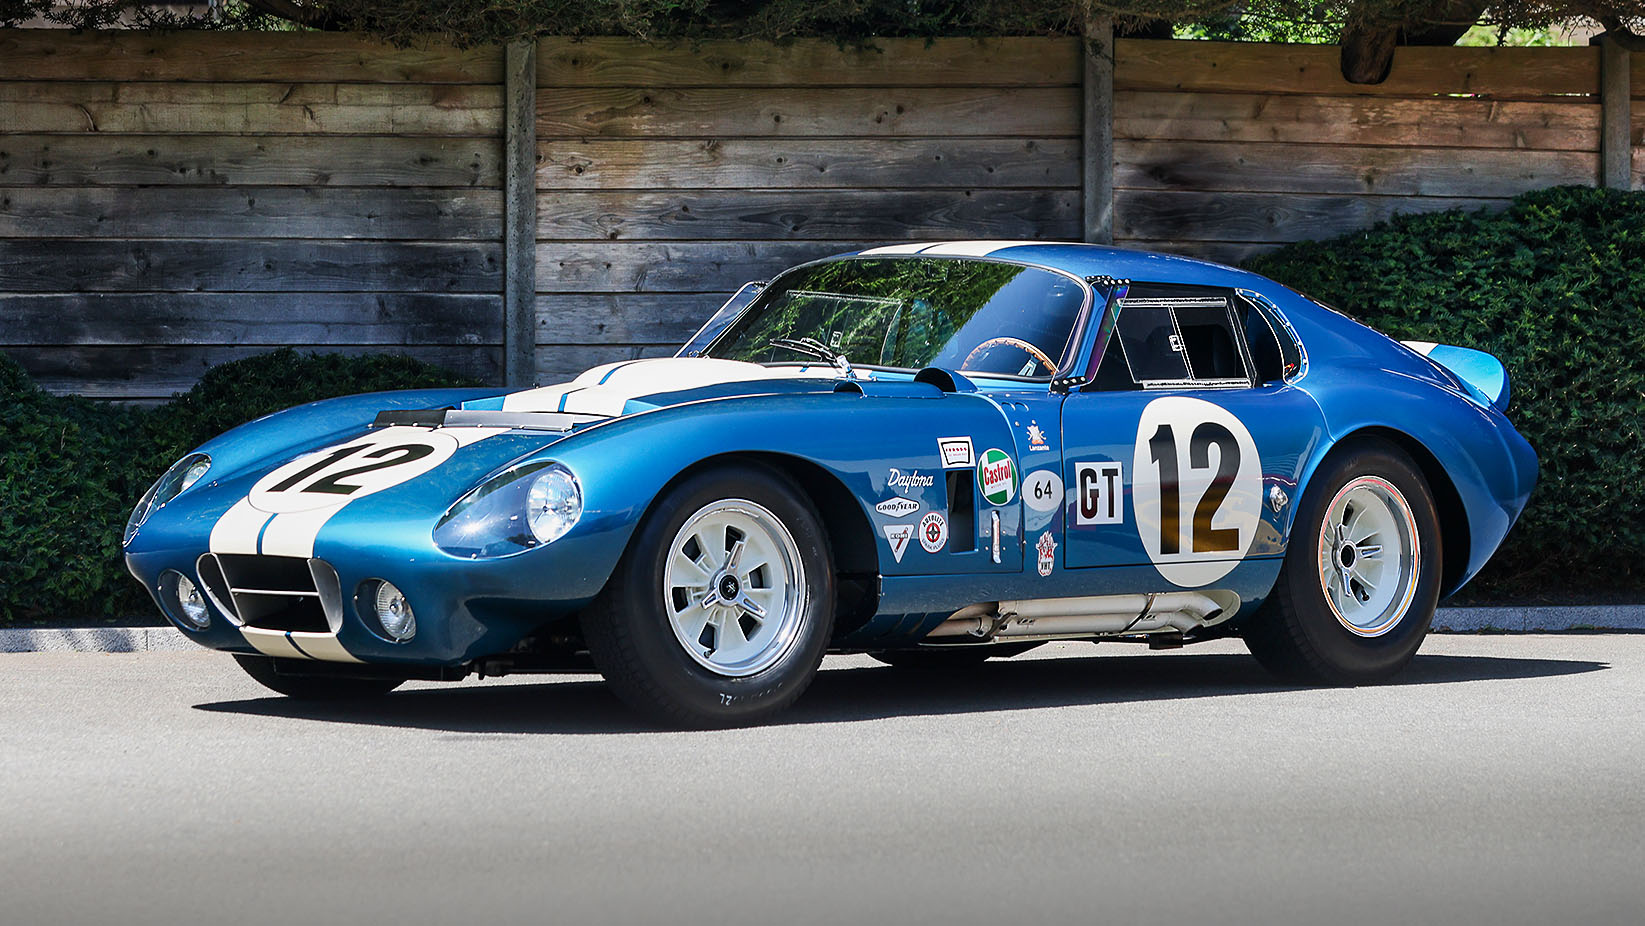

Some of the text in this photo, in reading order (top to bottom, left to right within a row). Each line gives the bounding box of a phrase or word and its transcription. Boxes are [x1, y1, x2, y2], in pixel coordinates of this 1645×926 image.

[266, 442, 435, 496] 12
[887, 468, 934, 494] Daytona
[984, 460, 1011, 486] Castrol
[1034, 480, 1053, 499] 64
[1080, 468, 1118, 519] GT
[1148, 421, 1241, 555] 12
[877, 501, 918, 512] GOODYEAR
[922, 514, 944, 528] AUTOLITE
